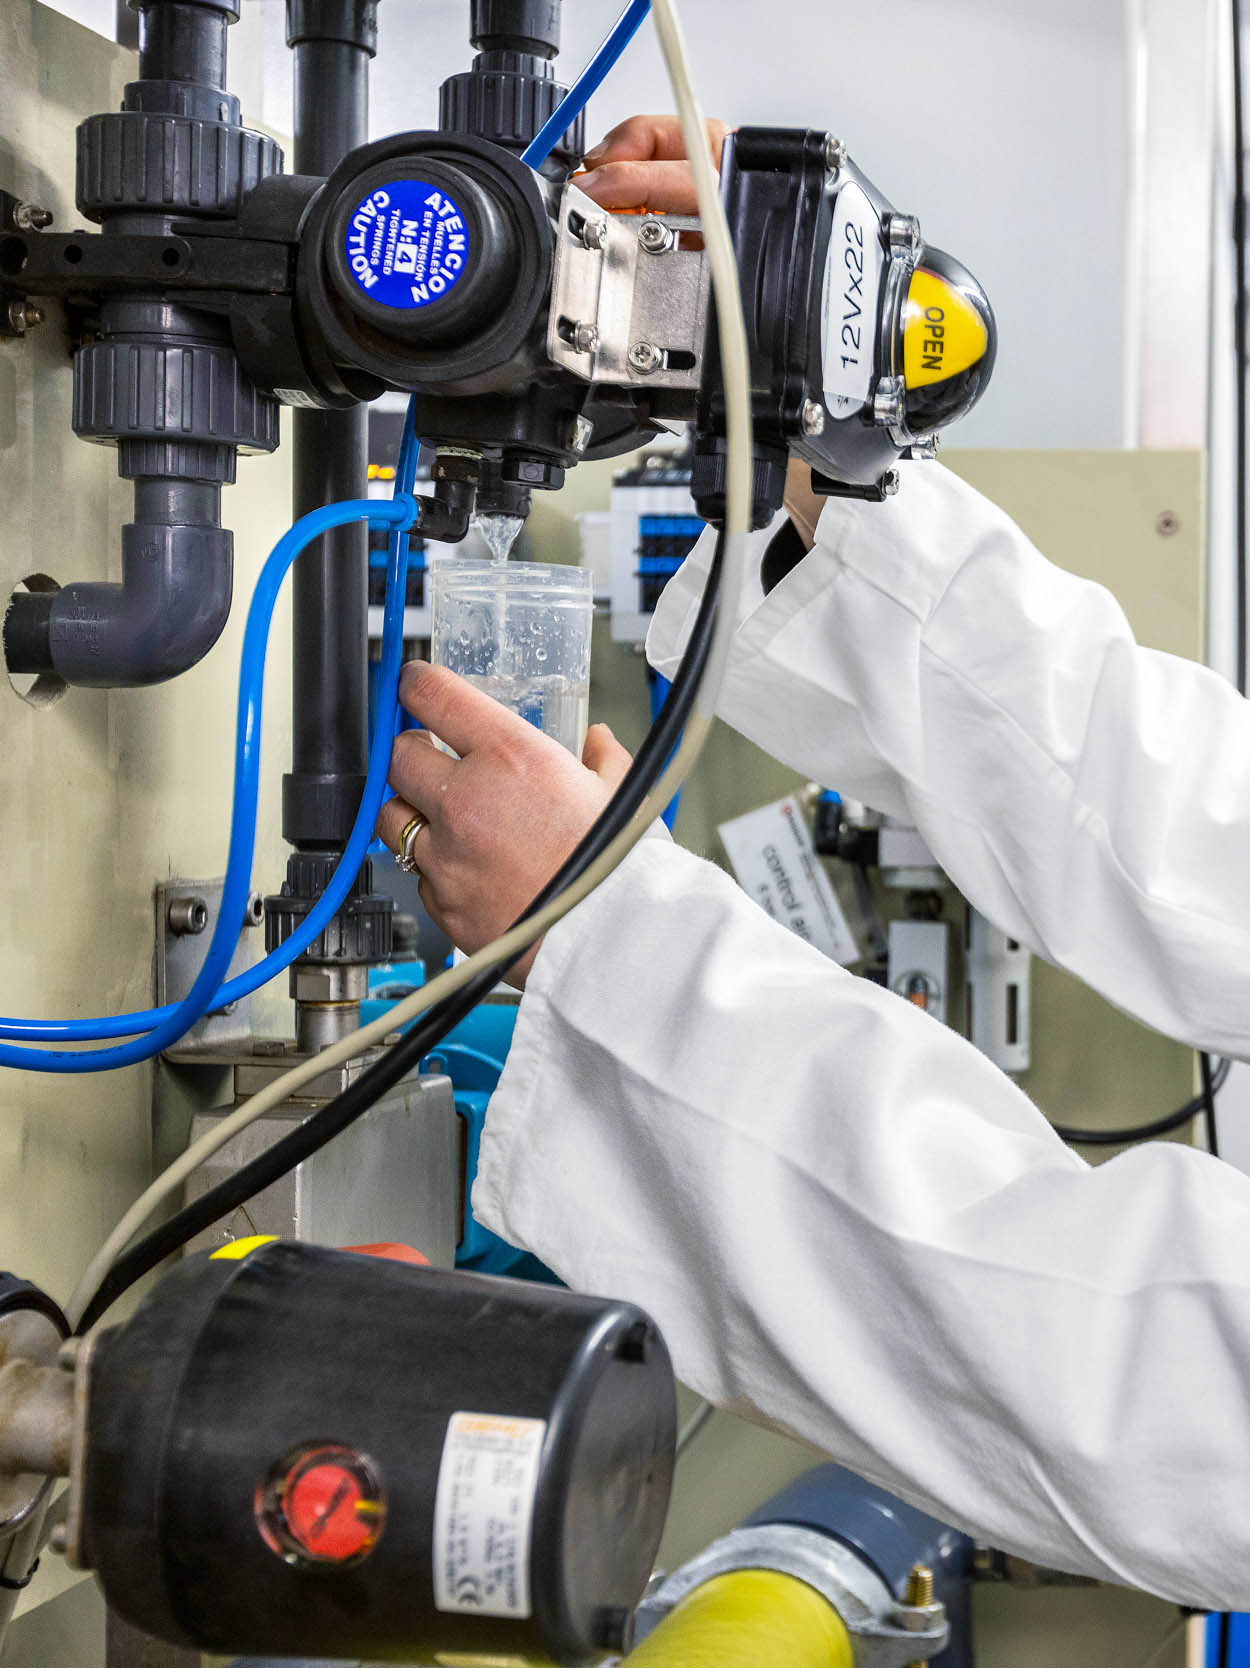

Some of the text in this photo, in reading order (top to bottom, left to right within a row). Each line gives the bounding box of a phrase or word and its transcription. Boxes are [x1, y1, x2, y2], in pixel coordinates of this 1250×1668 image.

[349, 191, 390, 289] CAUTION
[370, 214, 386, 265] SPRINGS
[383, 208, 401, 275] TIGHTENED
[398, 251, 412, 264] 4
[411, 192, 465, 303] ATENCION
[415, 211, 434, 282] EN TENSIÓN
[430, 220, 446, 275] MUELLES
[841, 221, 863, 369] 12Vx22
[921, 307, 944, 371] OPEN
[762, 844, 799, 910] control
